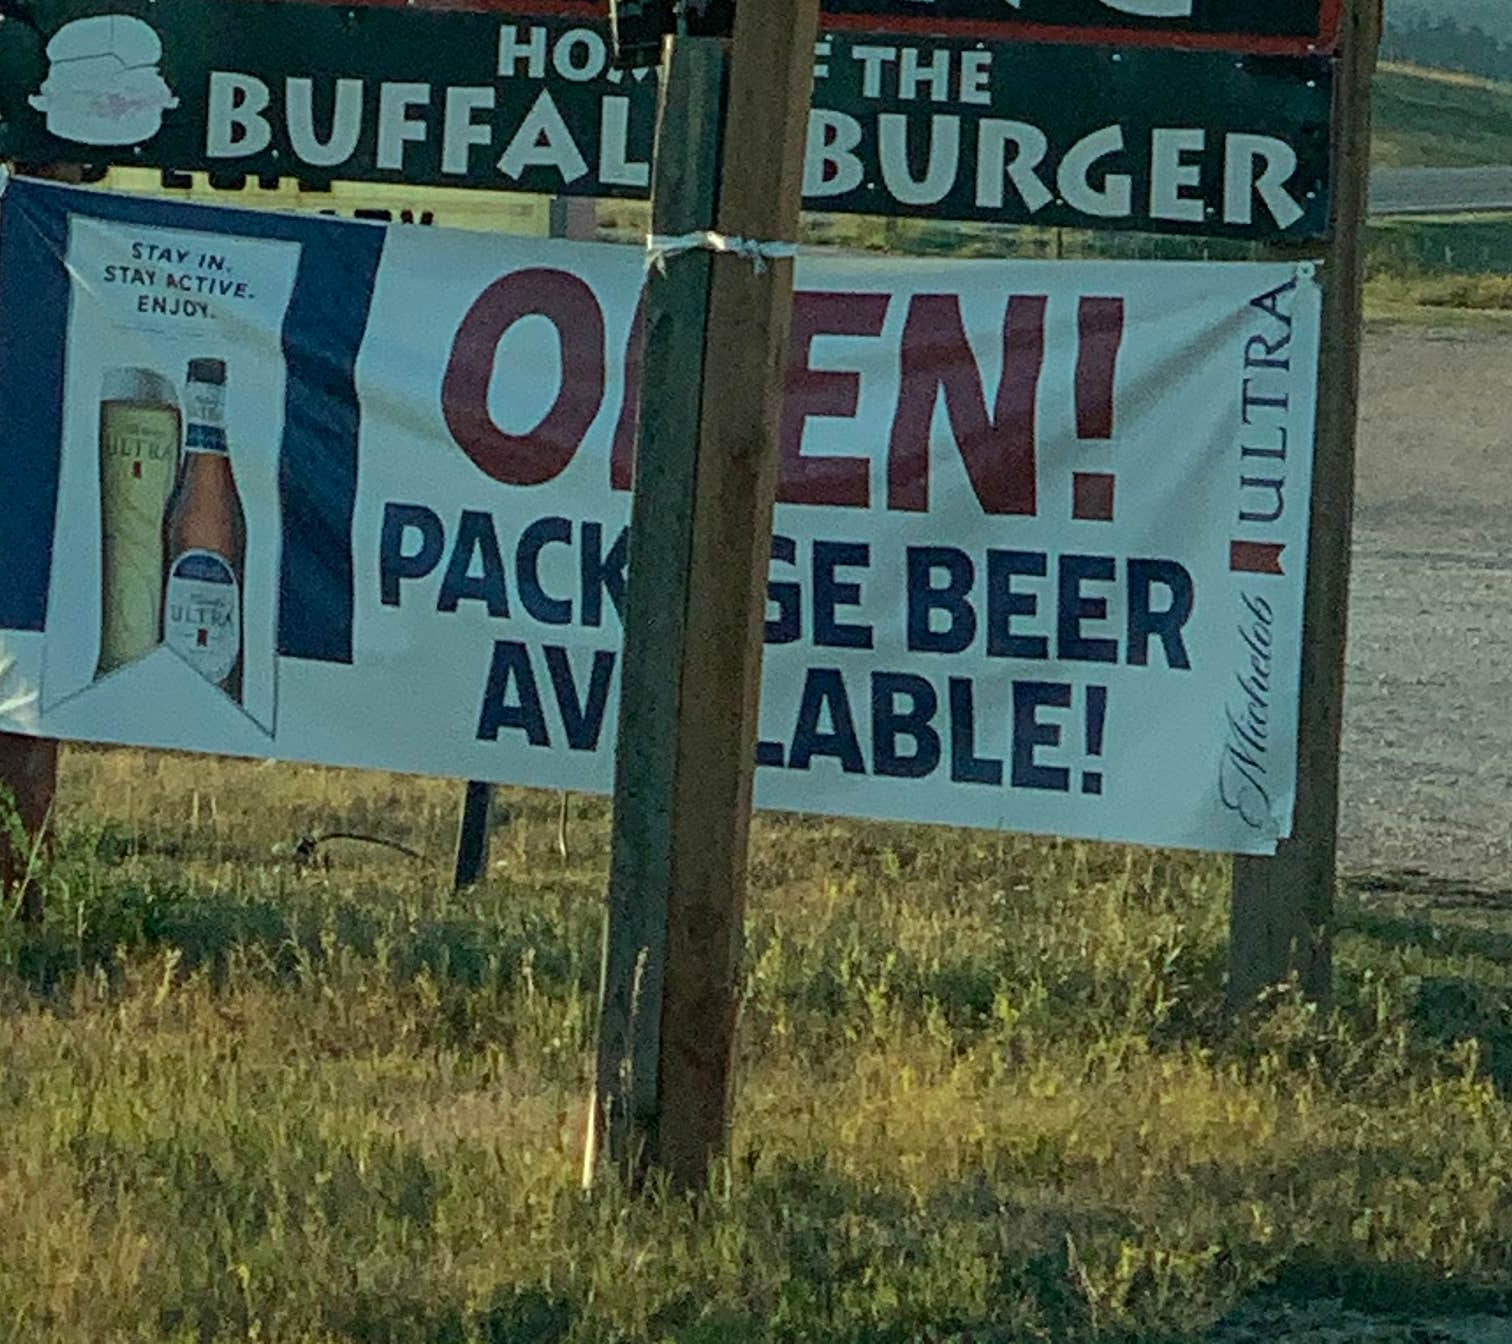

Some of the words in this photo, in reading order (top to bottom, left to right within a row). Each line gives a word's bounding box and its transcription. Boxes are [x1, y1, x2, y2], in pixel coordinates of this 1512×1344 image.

[496, 24, 662, 84] HO
[852, 44, 992, 105] THE
[206, 70, 650, 187] BUFFAL
[801, 108, 1306, 230] BURGER
[104, 265, 156, 286] STAY
[166, 273, 255, 300] ACTIVE.
[131, 242, 189, 264] STAY
[198, 254, 231, 273] IN.
[138, 295, 216, 320] ENJOY.
[442, 266, 1125, 522] OEN!
[1238, 276, 1299, 525] ULTRA
[380, 501, 875, 650] PACKGE
[905, 545, 1195, 670] BEER
[475, 639, 1108, 796] AVABLE!
[1218, 591, 1278, 831] Michelob
